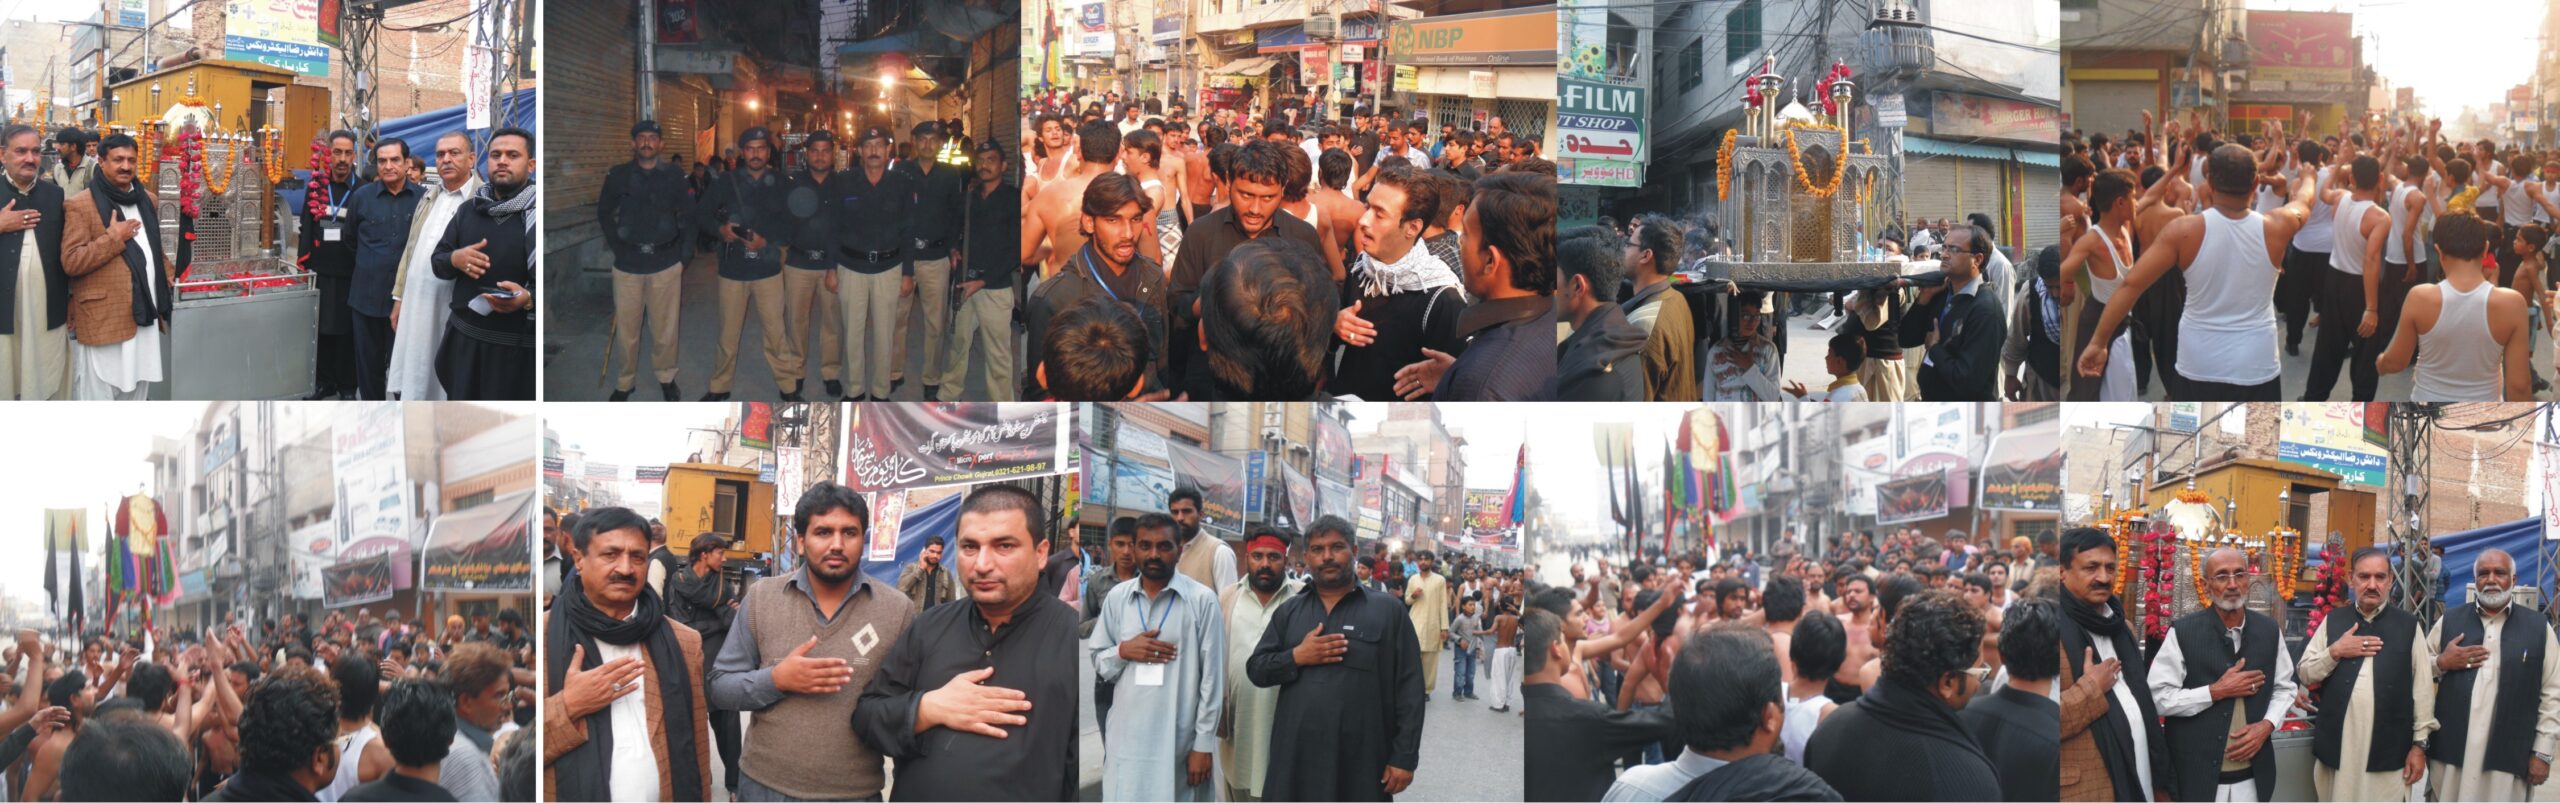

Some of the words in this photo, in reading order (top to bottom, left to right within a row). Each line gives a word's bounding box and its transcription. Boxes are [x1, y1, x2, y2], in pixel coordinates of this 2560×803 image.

[1418, 28, 1463, 49] NBP
[1416, 55, 1435, 63] National
[1487, 54, 1510, 63] Online
[1992, 109, 2032, 125] BURGER
[1575, 117, 1626, 130] SHOP
[1616, 168, 1636, 180] HD
[953, 473, 973, 481] Chowk
